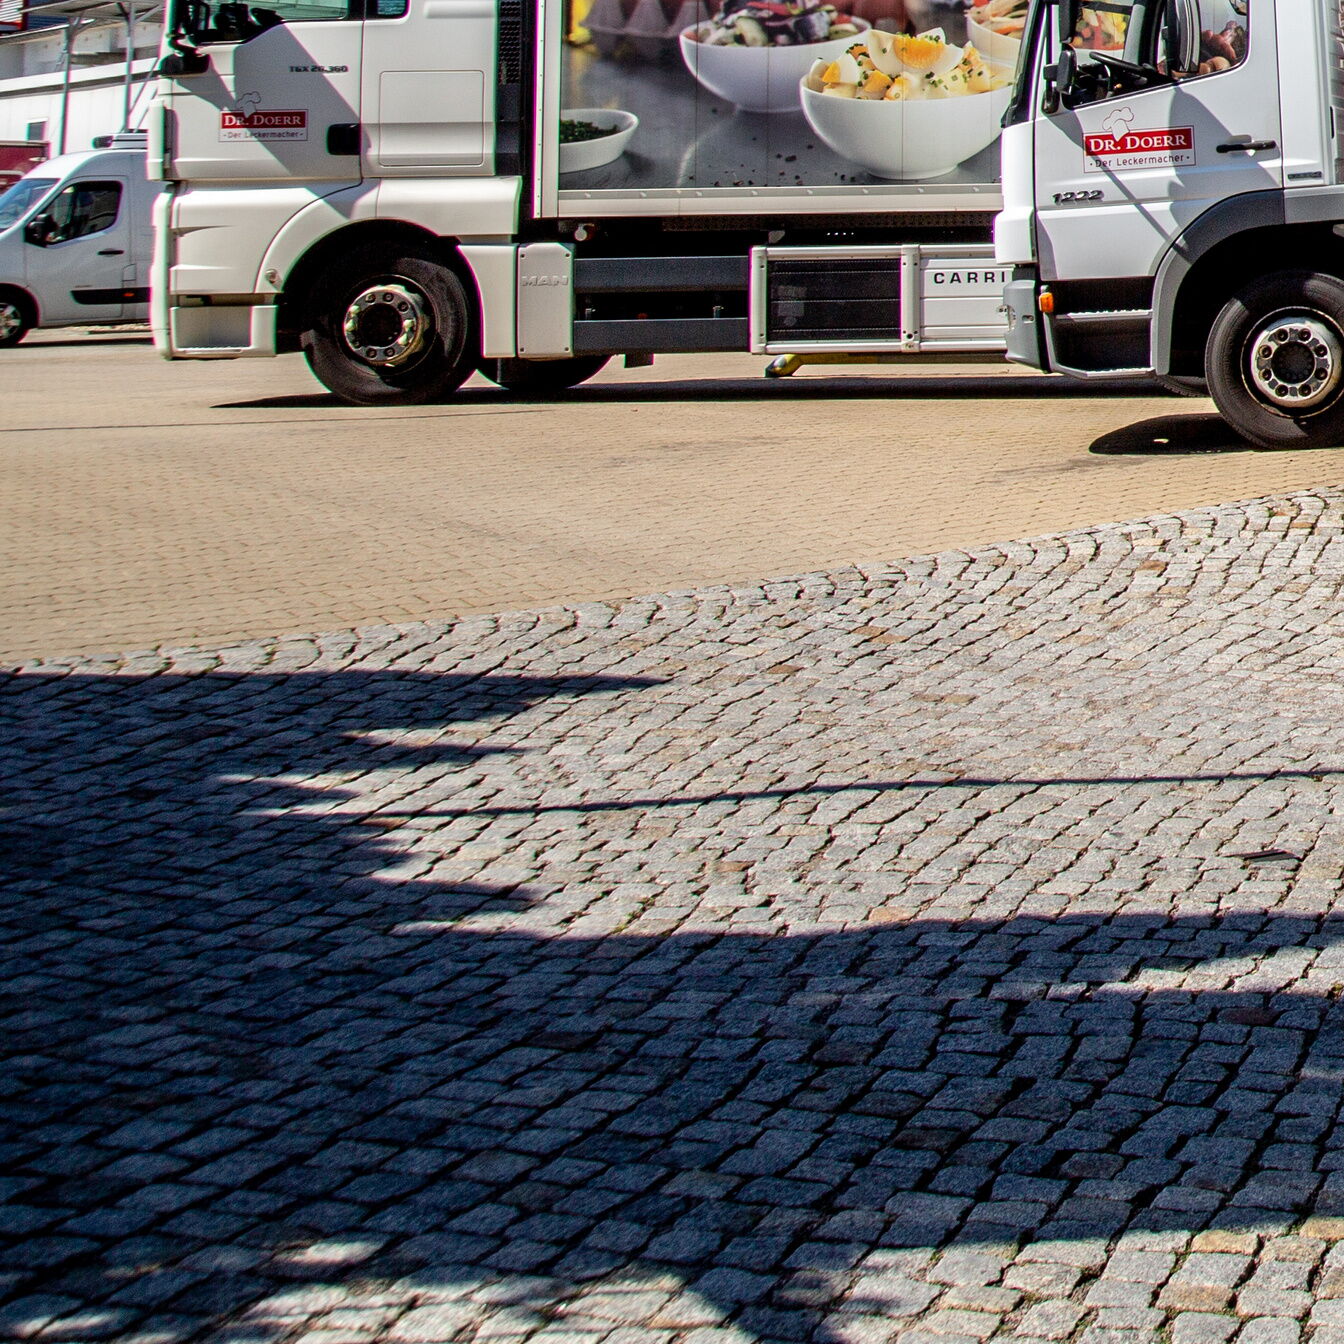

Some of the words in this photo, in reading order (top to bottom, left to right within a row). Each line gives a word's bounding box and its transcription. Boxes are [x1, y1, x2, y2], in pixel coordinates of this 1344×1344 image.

[224, 115, 249, 126] DR.
[253, 115, 301, 126] DOERR
[1089, 137, 1121, 153] DR.
[1126, 134, 1187, 150] DOERR
[1096, 157, 1111, 167] Der
[1116, 154, 1184, 167] Leckermacher
[1052, 190, 1104, 204] 1222
[934, 271, 1005, 284] CARRI
